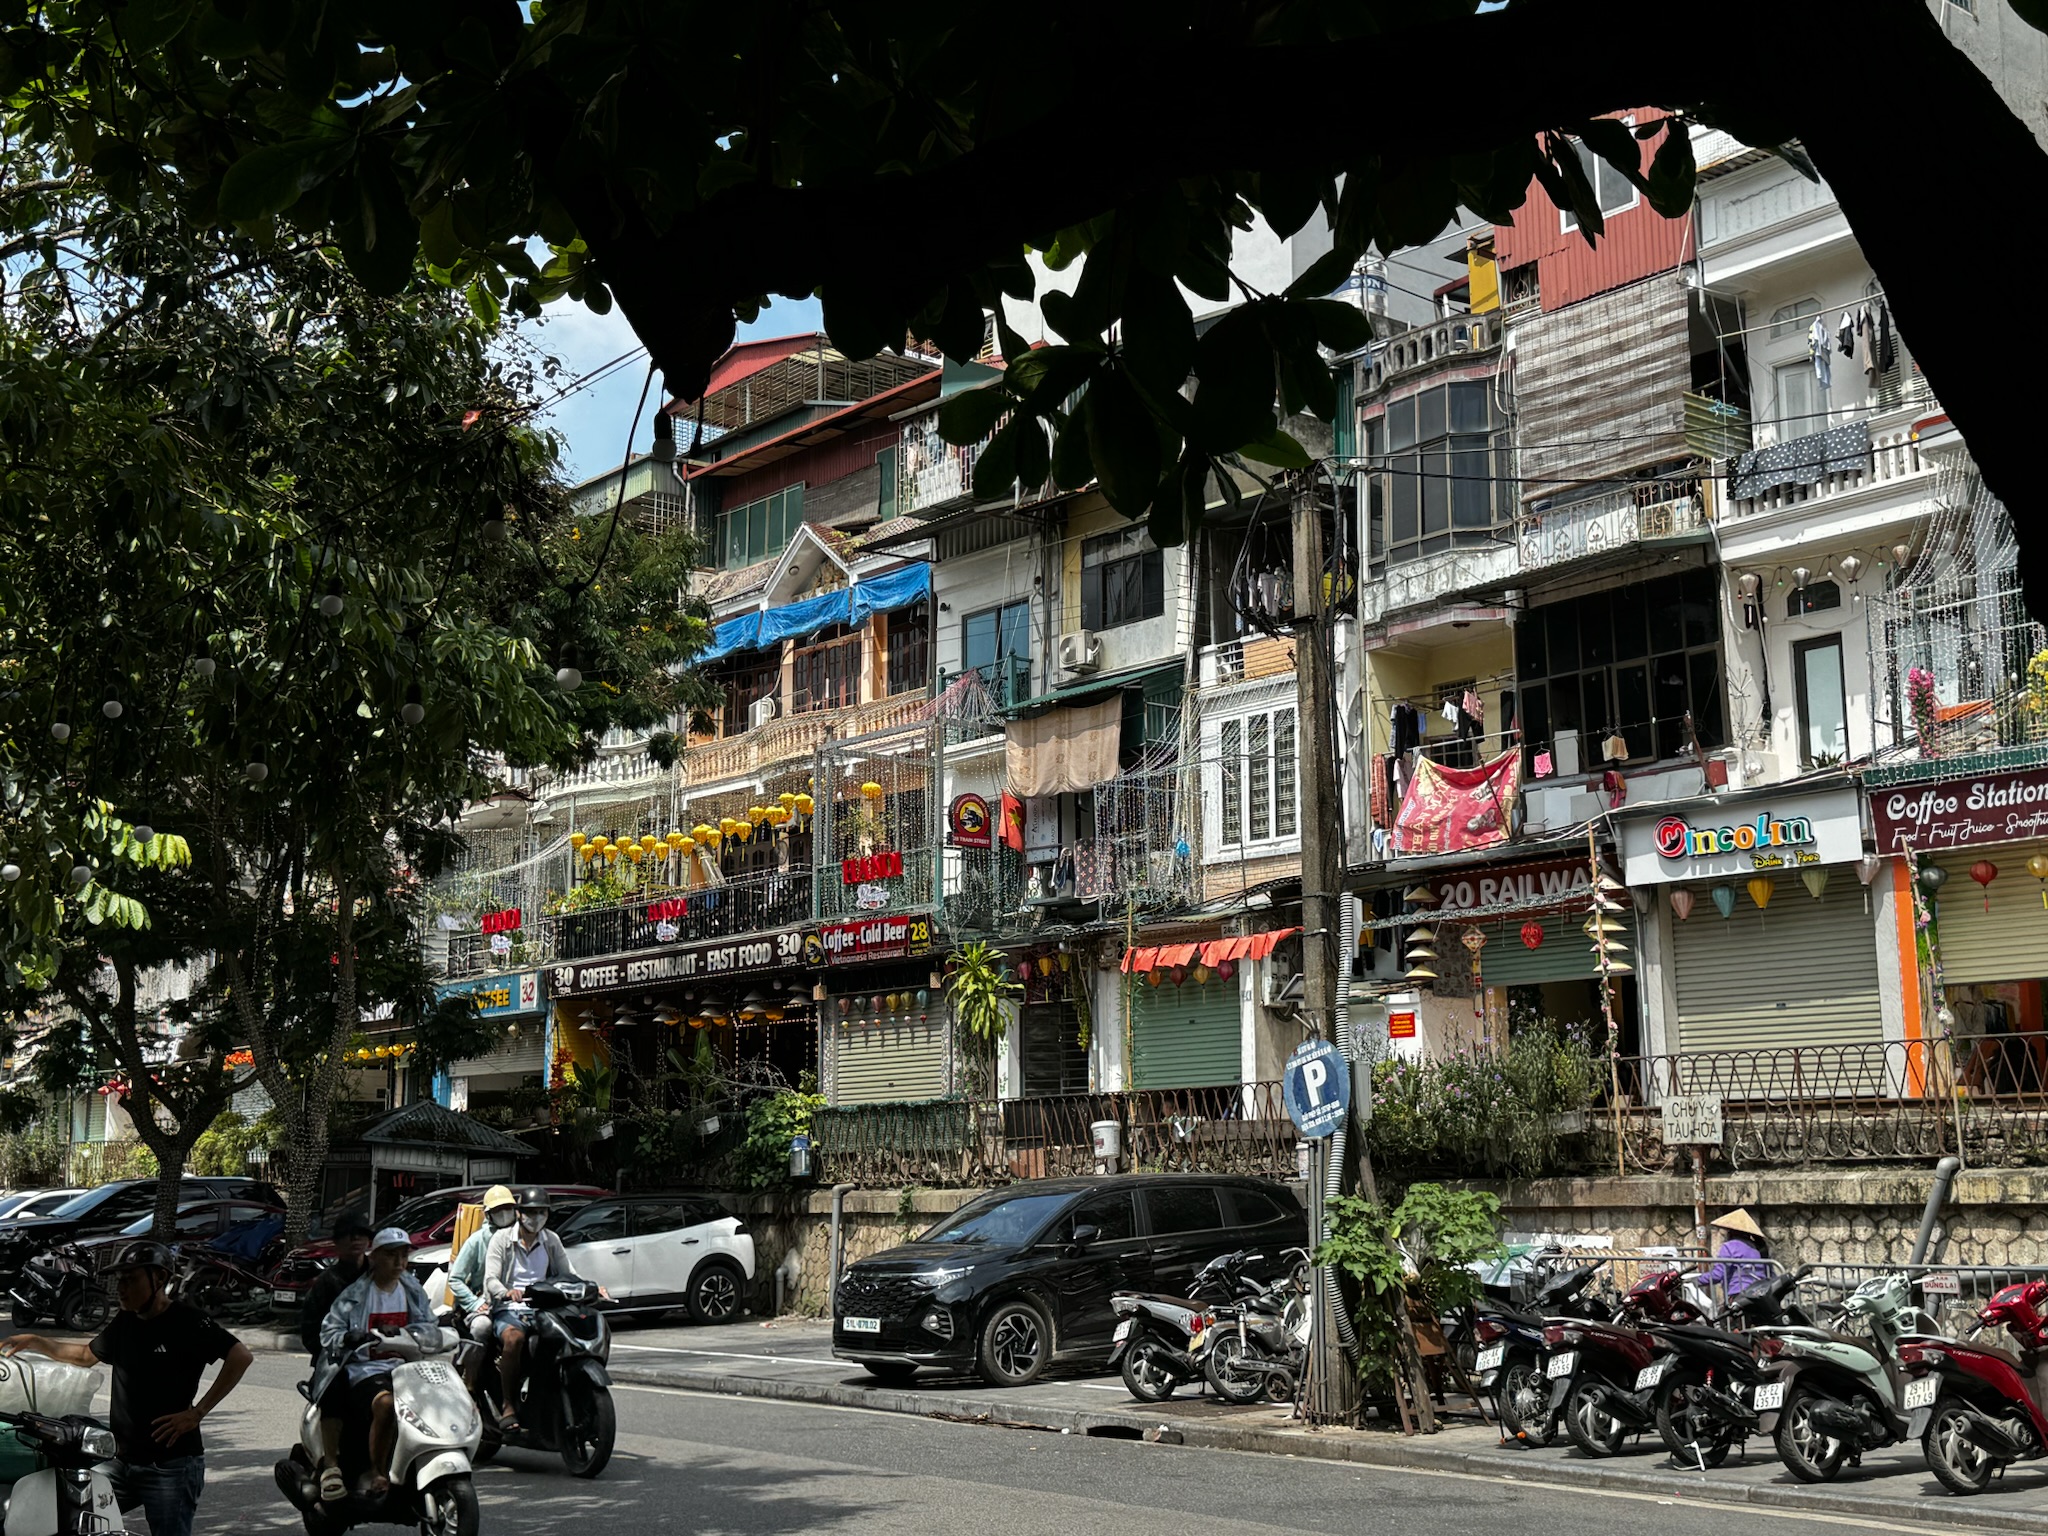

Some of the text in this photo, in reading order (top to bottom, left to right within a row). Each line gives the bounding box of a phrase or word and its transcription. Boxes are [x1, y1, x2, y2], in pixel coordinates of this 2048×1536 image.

[1886, 780, 2048, 825] Coffee Station
[1440, 866, 1592, 909] 20 RAILWA
[822, 928, 854, 953] Coffee
[860, 924, 882, 945] Cold
[883, 922, 907, 942] Beer
[909, 921, 929, 942] 28
[555, 966, 574, 987] 30
[580, 965, 619, 988] COFFEE
[627, 953, 698, 982] RESTAURANT
[706, 948, 736, 971] FAST
[738, 942, 772, 967] FOOD
[777, 933, 801, 956] 30
[830, 951, 868, 965] Vietnamese
[868, 948, 905, 960] Restaurant
[522, 981, 535, 1004] 32
[1302, 1059, 1327, 1108] P
